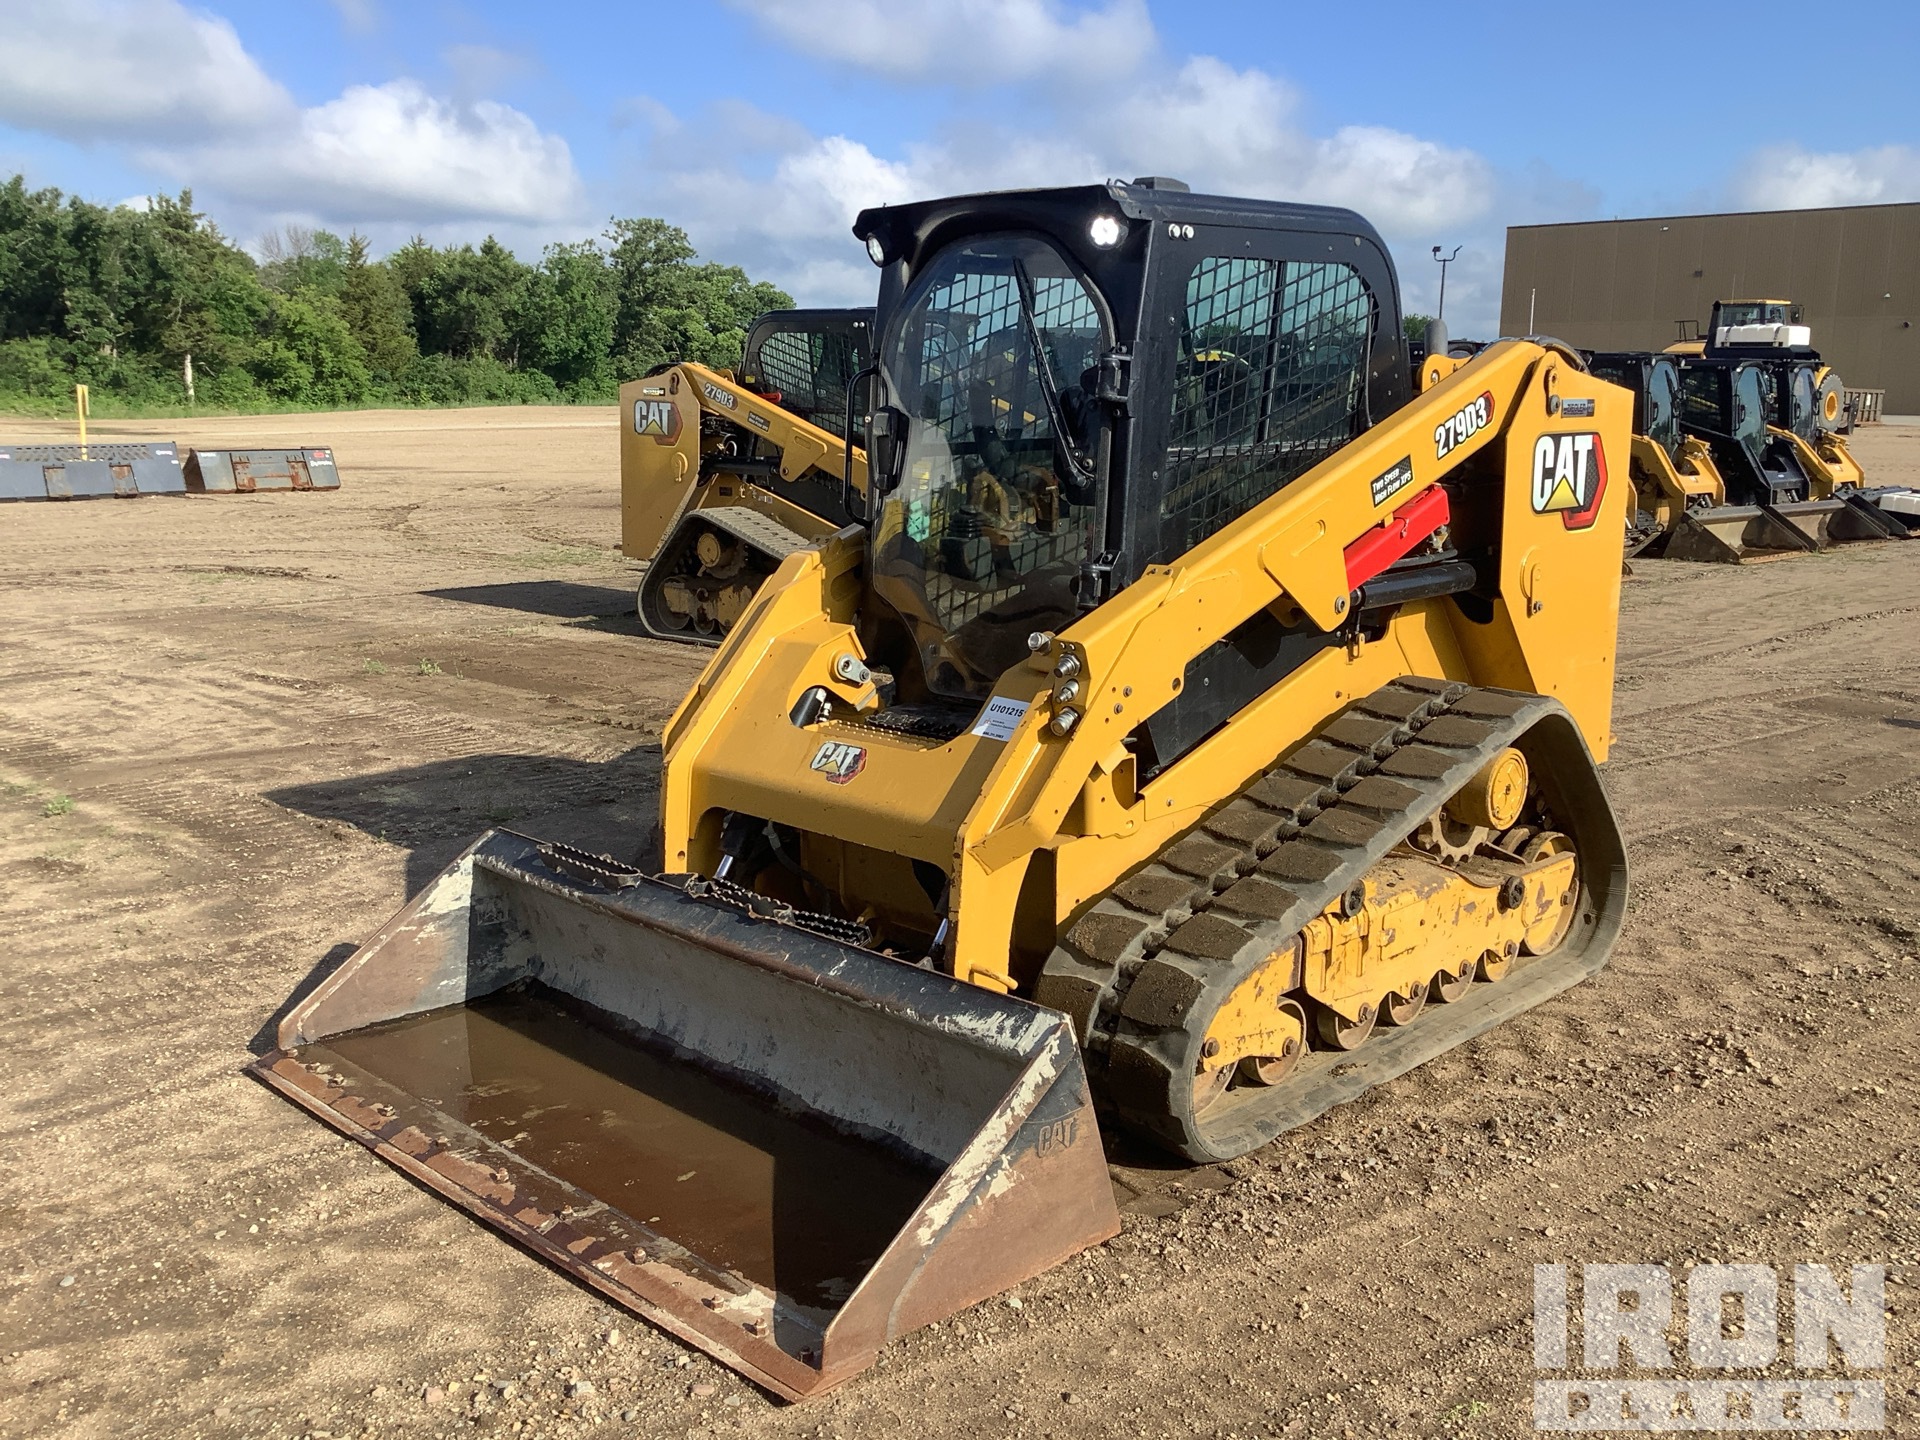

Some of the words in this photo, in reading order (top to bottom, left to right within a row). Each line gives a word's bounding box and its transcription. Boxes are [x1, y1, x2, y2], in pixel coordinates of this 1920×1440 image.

[704, 382, 734, 409] 279D3
[635, 400, 671, 436] CAT
[1434, 396, 1488, 459] 279D3
[1532, 434, 1594, 512] CAT
[811, 742, 862, 775] CAT
[1038, 1117, 1075, 1158] CAT
